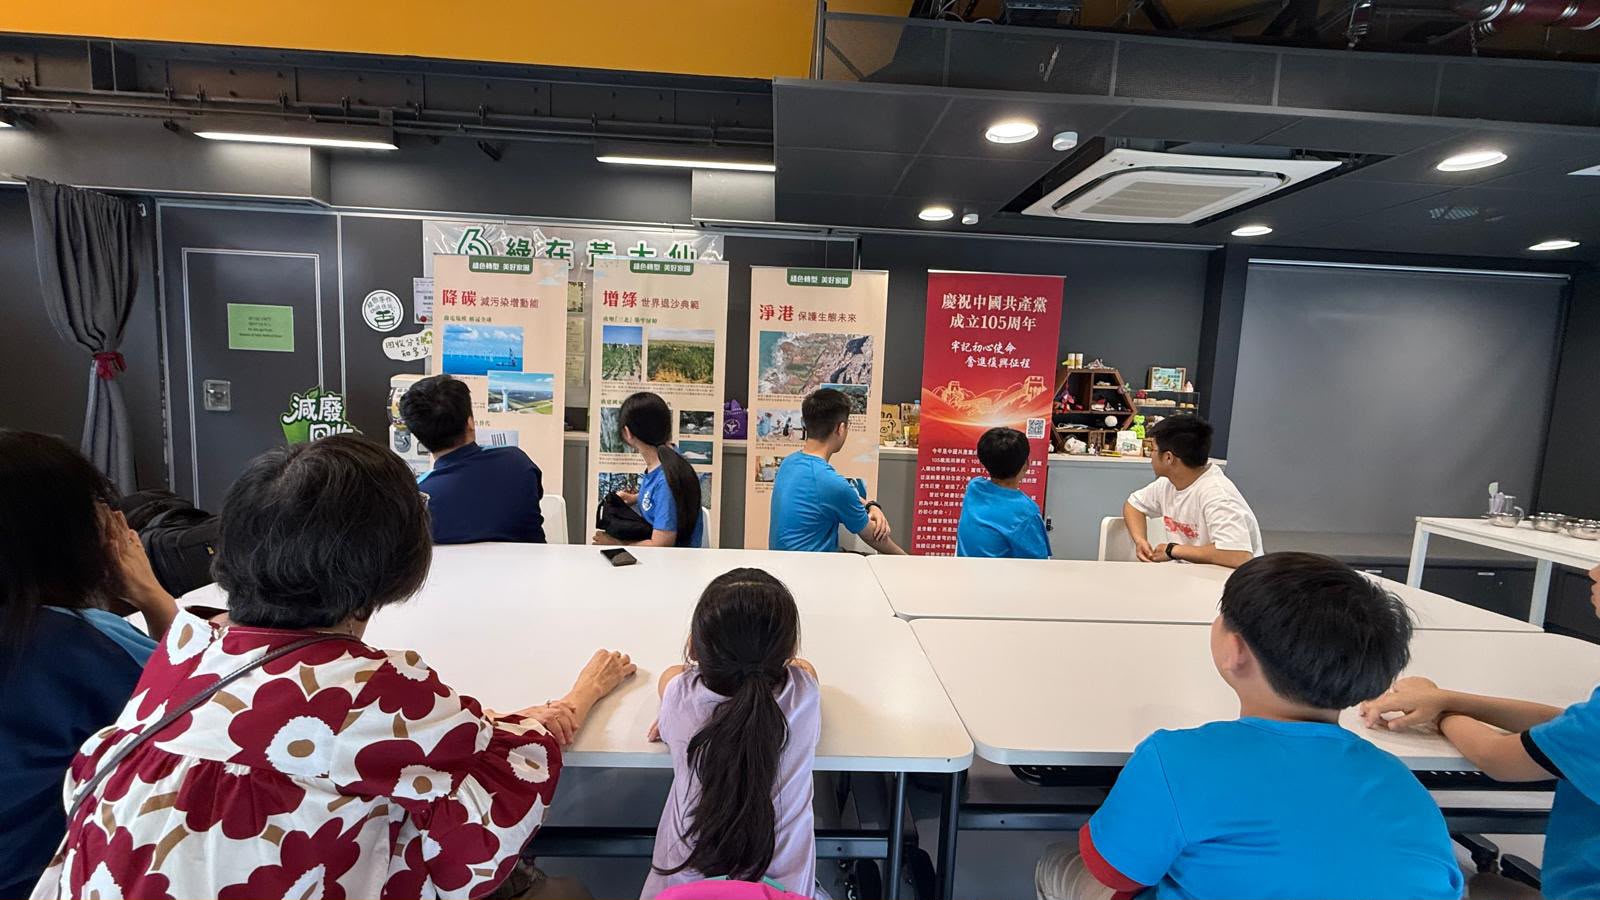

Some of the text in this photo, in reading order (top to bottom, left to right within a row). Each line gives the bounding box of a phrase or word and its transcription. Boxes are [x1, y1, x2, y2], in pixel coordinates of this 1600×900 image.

[821, 276, 849, 285] 美好家園
[442, 289, 477, 306] 降碳
[480, 297, 538, 308] 減污染增動能
[603, 290, 637, 308] 增綠
[941, 293, 1048, 313] 慶祝中國共產黨
[759, 304, 857, 323] 淨港 保護生態未來
[949, 314, 1037, 332] 成立105周年
[950, 340, 1017, 354] 牢記初心使命
[965, 355, 1031, 369] 奮進復興征程
[283, 394, 343, 423] 減廢
